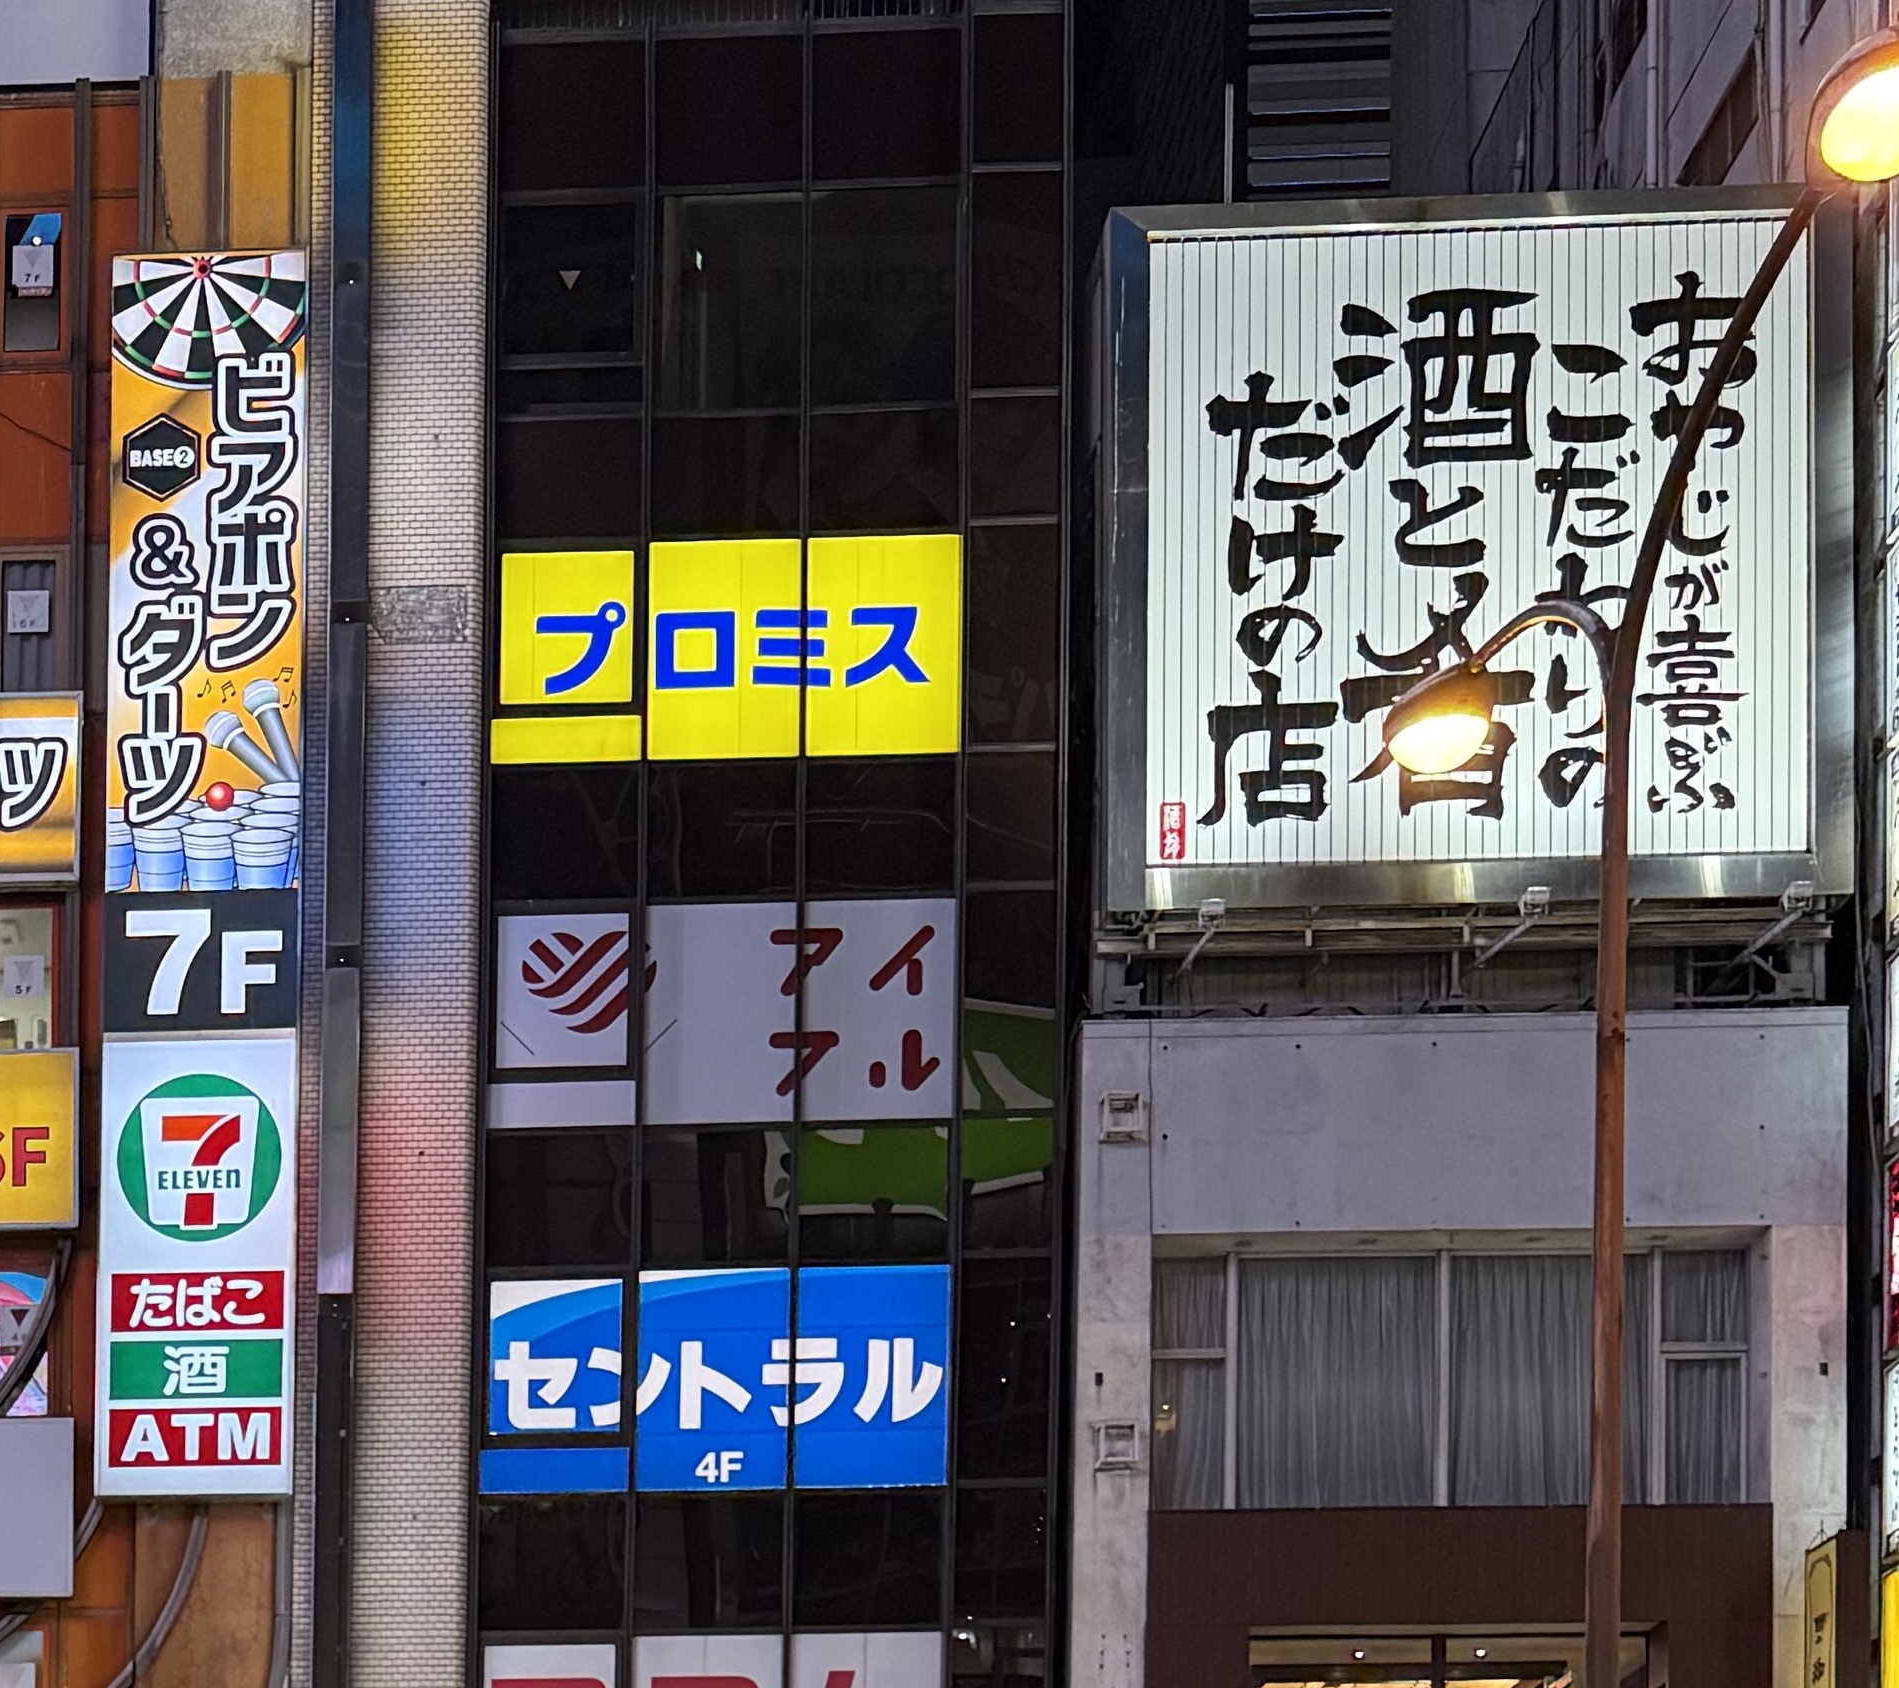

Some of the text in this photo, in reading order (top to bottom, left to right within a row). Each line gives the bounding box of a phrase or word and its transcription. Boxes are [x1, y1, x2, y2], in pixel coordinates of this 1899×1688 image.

[209, 351, 299, 672] ビアポン
[1629, 270, 1757, 815] おやじが喜ぶ
[1197, 372, 1352, 829] だけの店
[1535, 342, 1642, 810] こだわりの
[119, 512, 207, 824] &ダーツ
[535, 600, 931, 696] プロミス
[14, 984, 33, 995] 5F
[124, 907, 285, 1017] 7F
[768, 925, 936, 997] アイ
[768, 1028, 942, 1098] フル
[161, 1114, 242, 1228] 7
[127, 1276, 267, 1328] たばこ
[163, 1345, 229, 1395] 酒
[493, 1336, 944, 1431] セントラル
[122, 1415, 272, 1461] ATM
[693, 1450, 745, 1484] 4F
